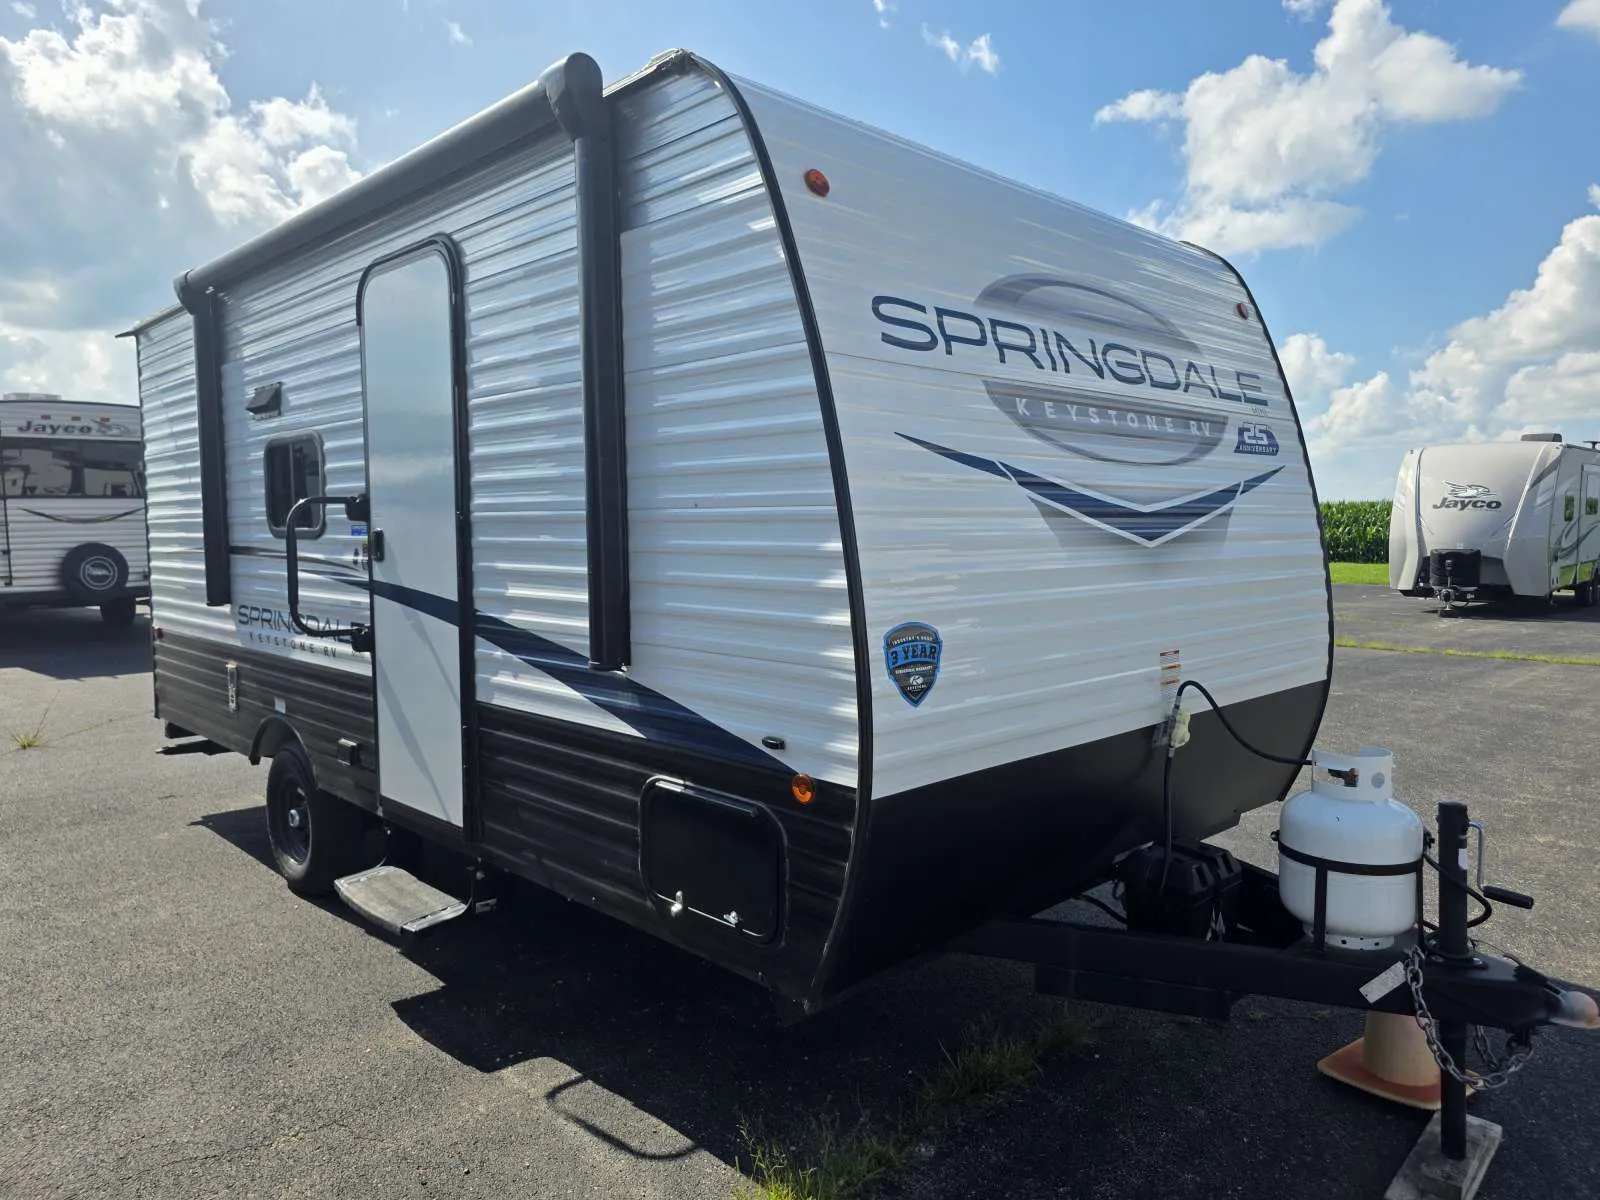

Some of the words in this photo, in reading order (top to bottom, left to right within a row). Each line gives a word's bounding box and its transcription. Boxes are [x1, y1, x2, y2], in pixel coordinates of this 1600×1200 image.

[871, 295, 1269, 407] SPRINGDALE
[18, 420, 92, 435] Jayco
[1015, 397, 1177, 433] KEYSTONE
[1189, 420, 1211, 437] RV
[1432, 497, 1503, 511] Jayco
[248, 631, 315, 654] KEYSTONE
[323, 646, 337, 658] RV
[890, 650, 899, 666] 3
[902, 643, 937, 660] YEAR
